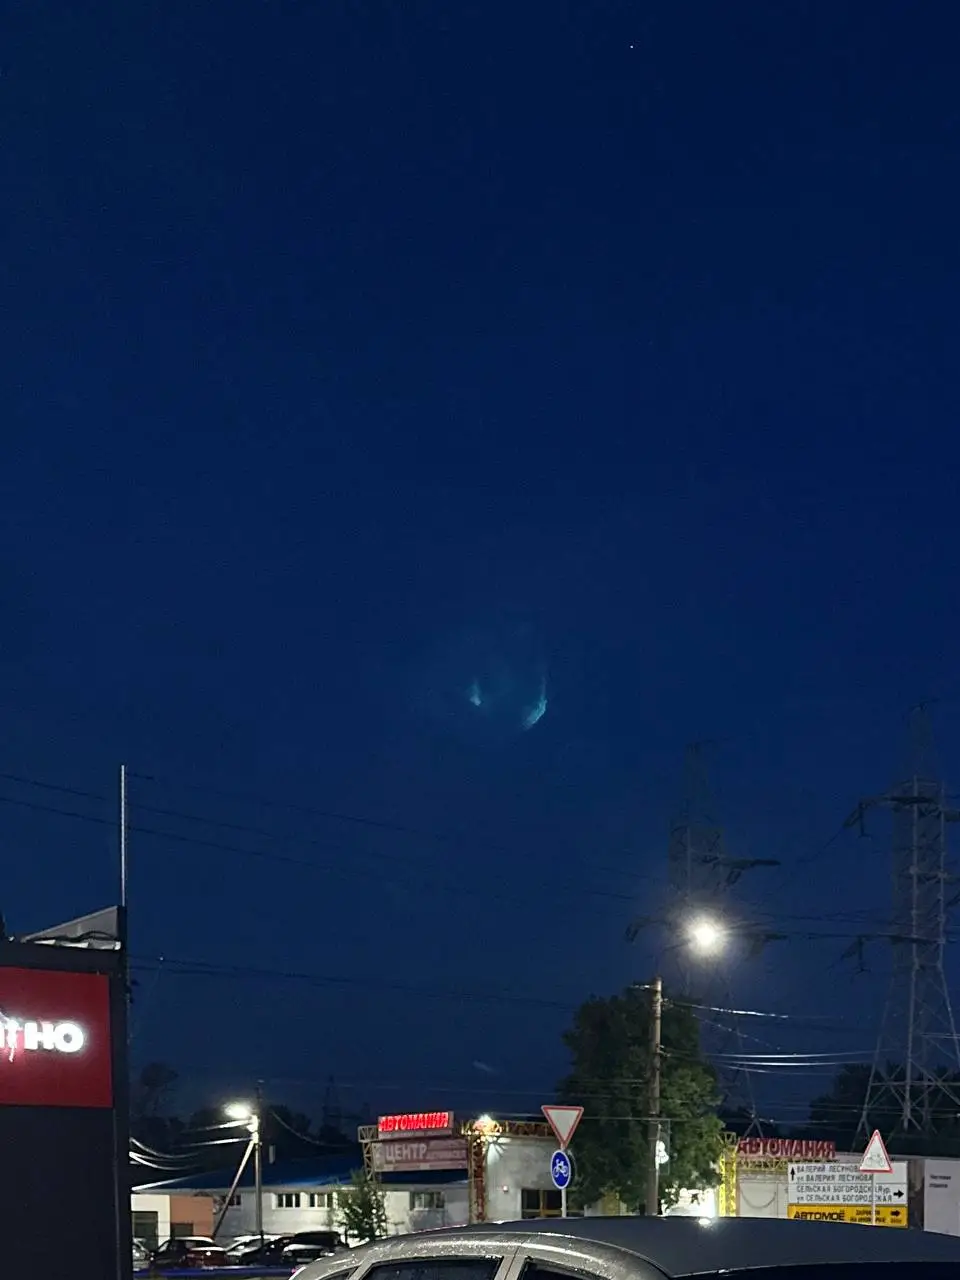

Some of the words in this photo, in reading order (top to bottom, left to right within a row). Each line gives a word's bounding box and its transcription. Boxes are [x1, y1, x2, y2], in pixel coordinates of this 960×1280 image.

[378, 1111, 449, 1132] АВТОМАНИЯ
[385, 1142, 428, 1163] ЦЕНТР
[737, 1137, 836, 1158] АВТОМАНИЯ
[796, 1164, 826, 1172] ВАЛЕРИЙ
[796, 1185, 830, 1193] СЕЛЬСКАЯ
[806, 1194, 840, 1202] СЕЛЬСКАЯ
